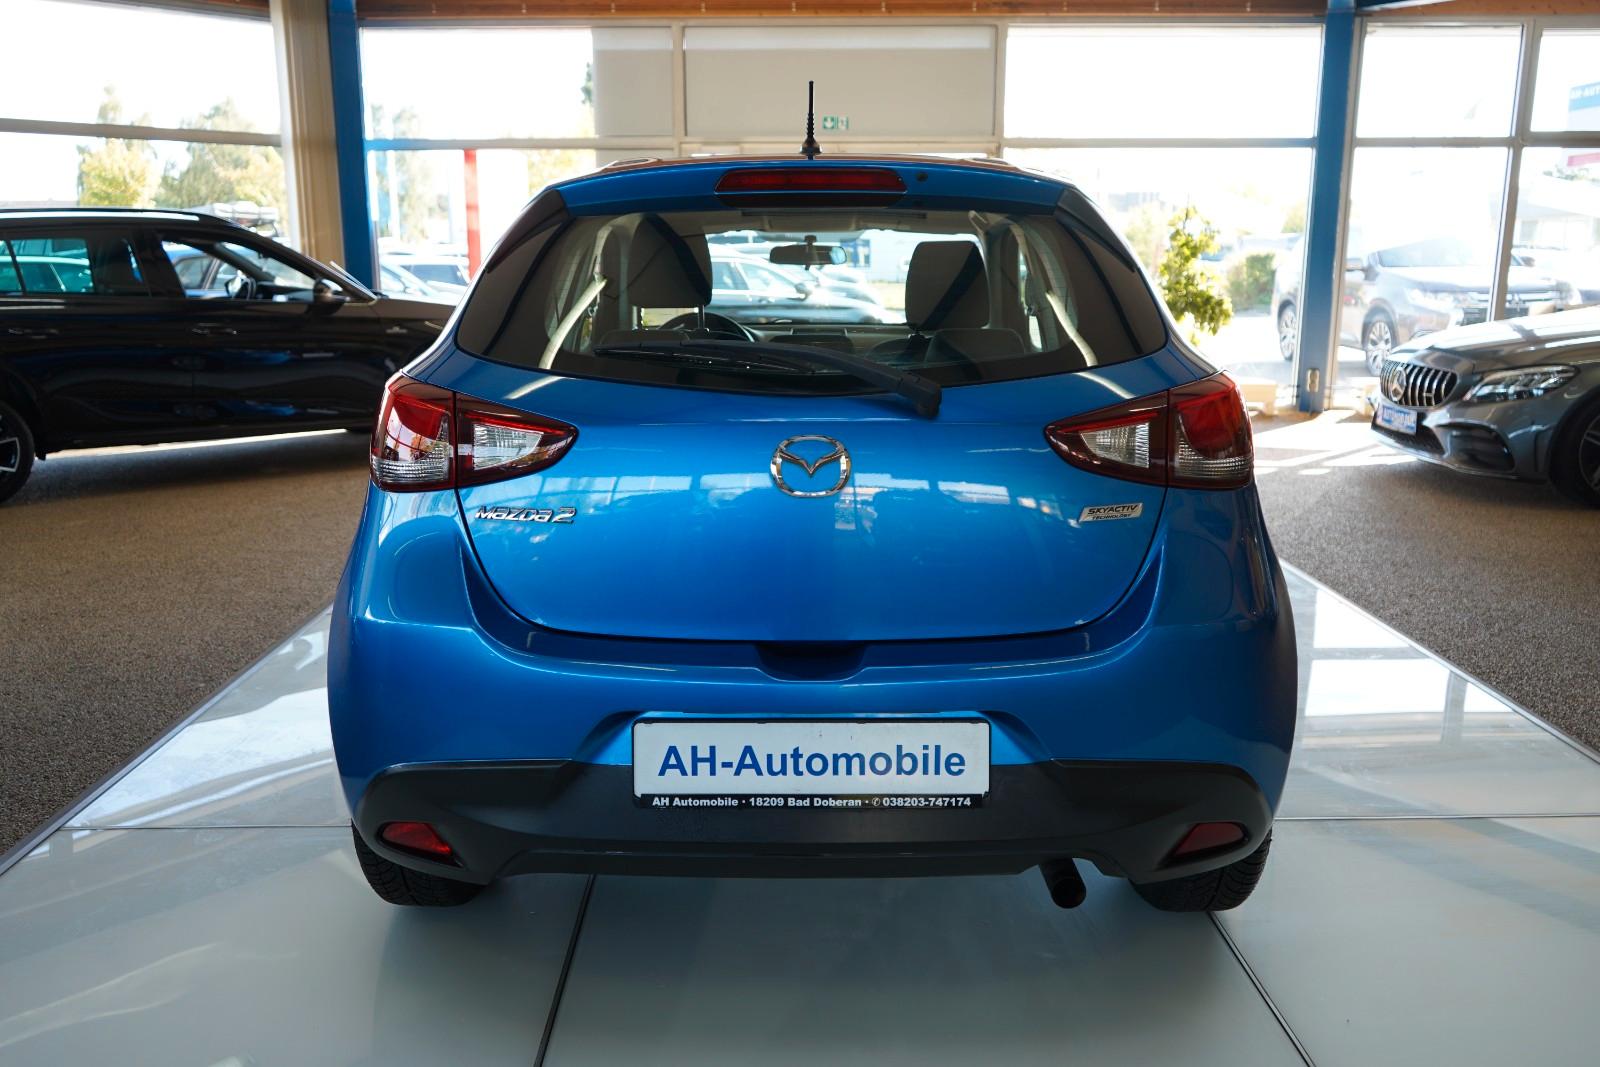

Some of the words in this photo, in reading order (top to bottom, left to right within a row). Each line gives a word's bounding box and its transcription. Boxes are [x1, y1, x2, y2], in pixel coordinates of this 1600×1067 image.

[1088, 505, 1139, 514] SKYACTIV
[657, 744, 966, 776] AH-Automobile
[652, 797, 670, 807] AH
[672, 797, 739, 807] Automobile
[749, 797, 785, 807] 18209
[787, 797, 810, 807] Bad
[813, 797, 862, 807] Doberan
[882, 797, 972, 807] 038203-747174
